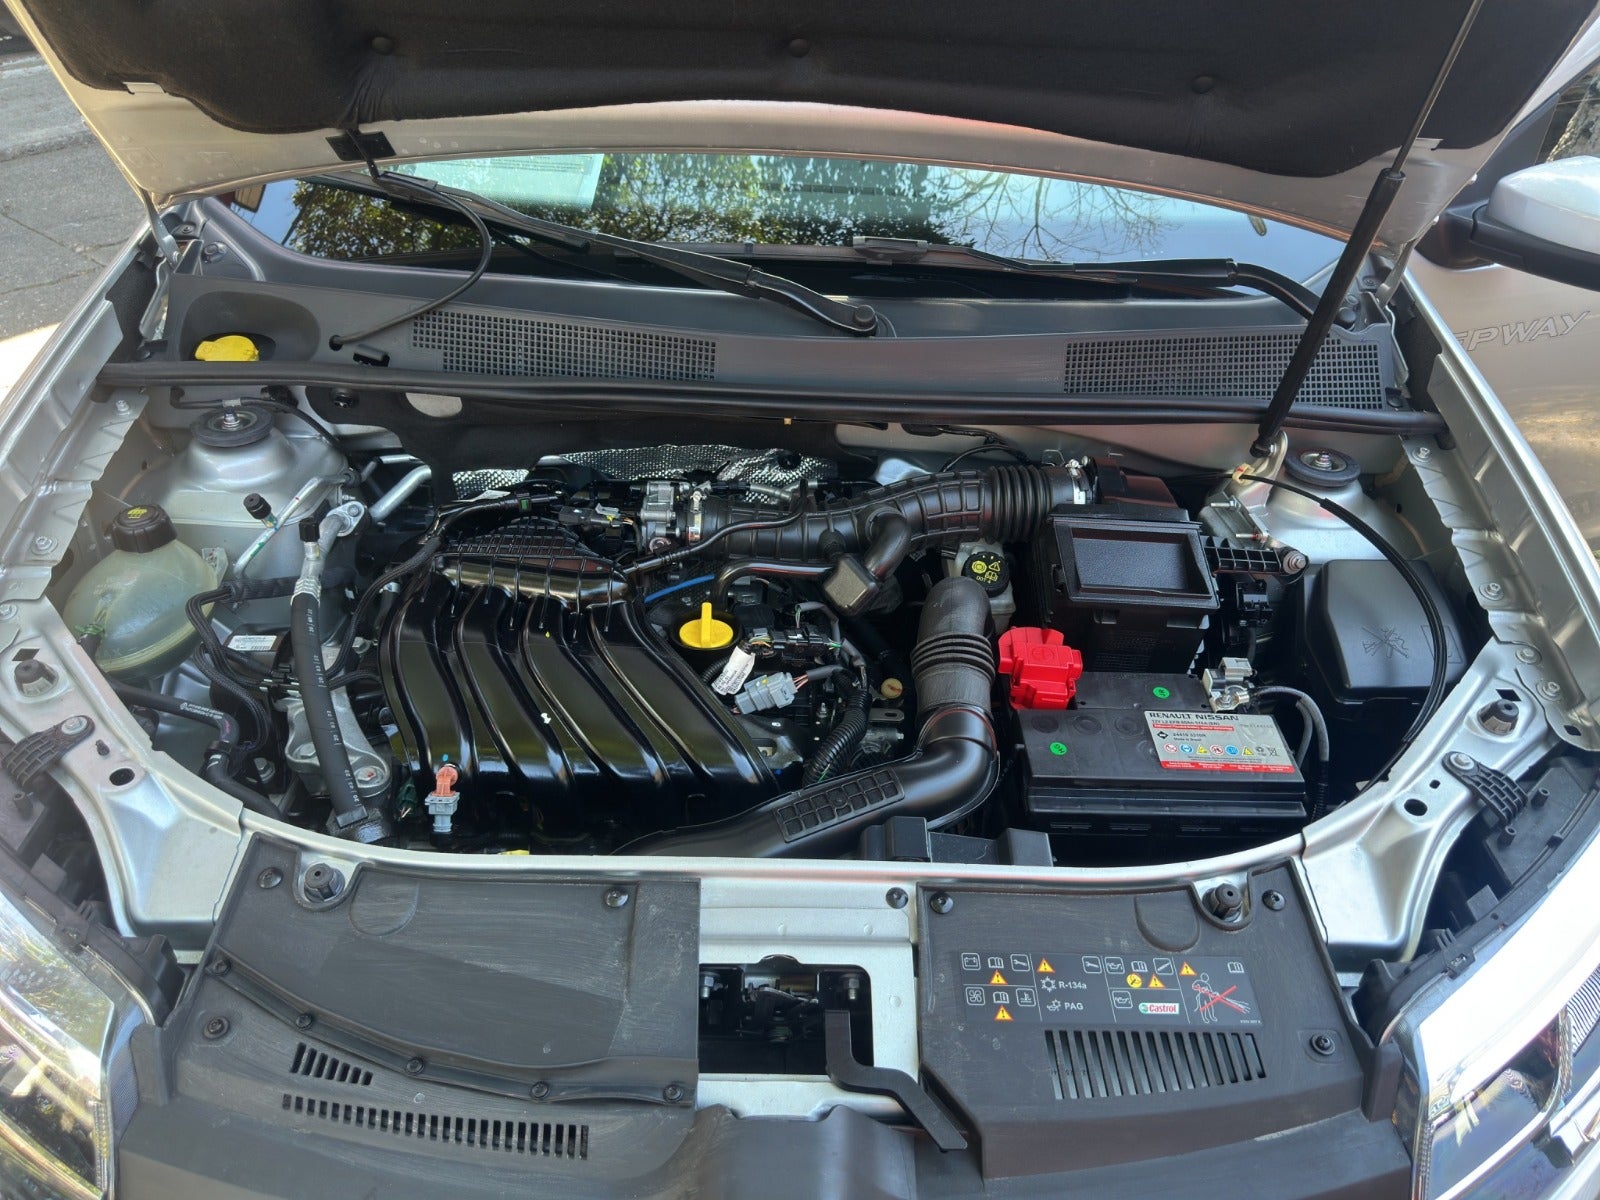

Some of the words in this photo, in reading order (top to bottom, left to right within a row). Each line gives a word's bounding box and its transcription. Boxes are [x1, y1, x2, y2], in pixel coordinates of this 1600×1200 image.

[1058, 981, 1087, 990] R-134a
[1064, 1002, 1084, 1010] PAG
[1149, 1004, 1177, 1013] Castrol
